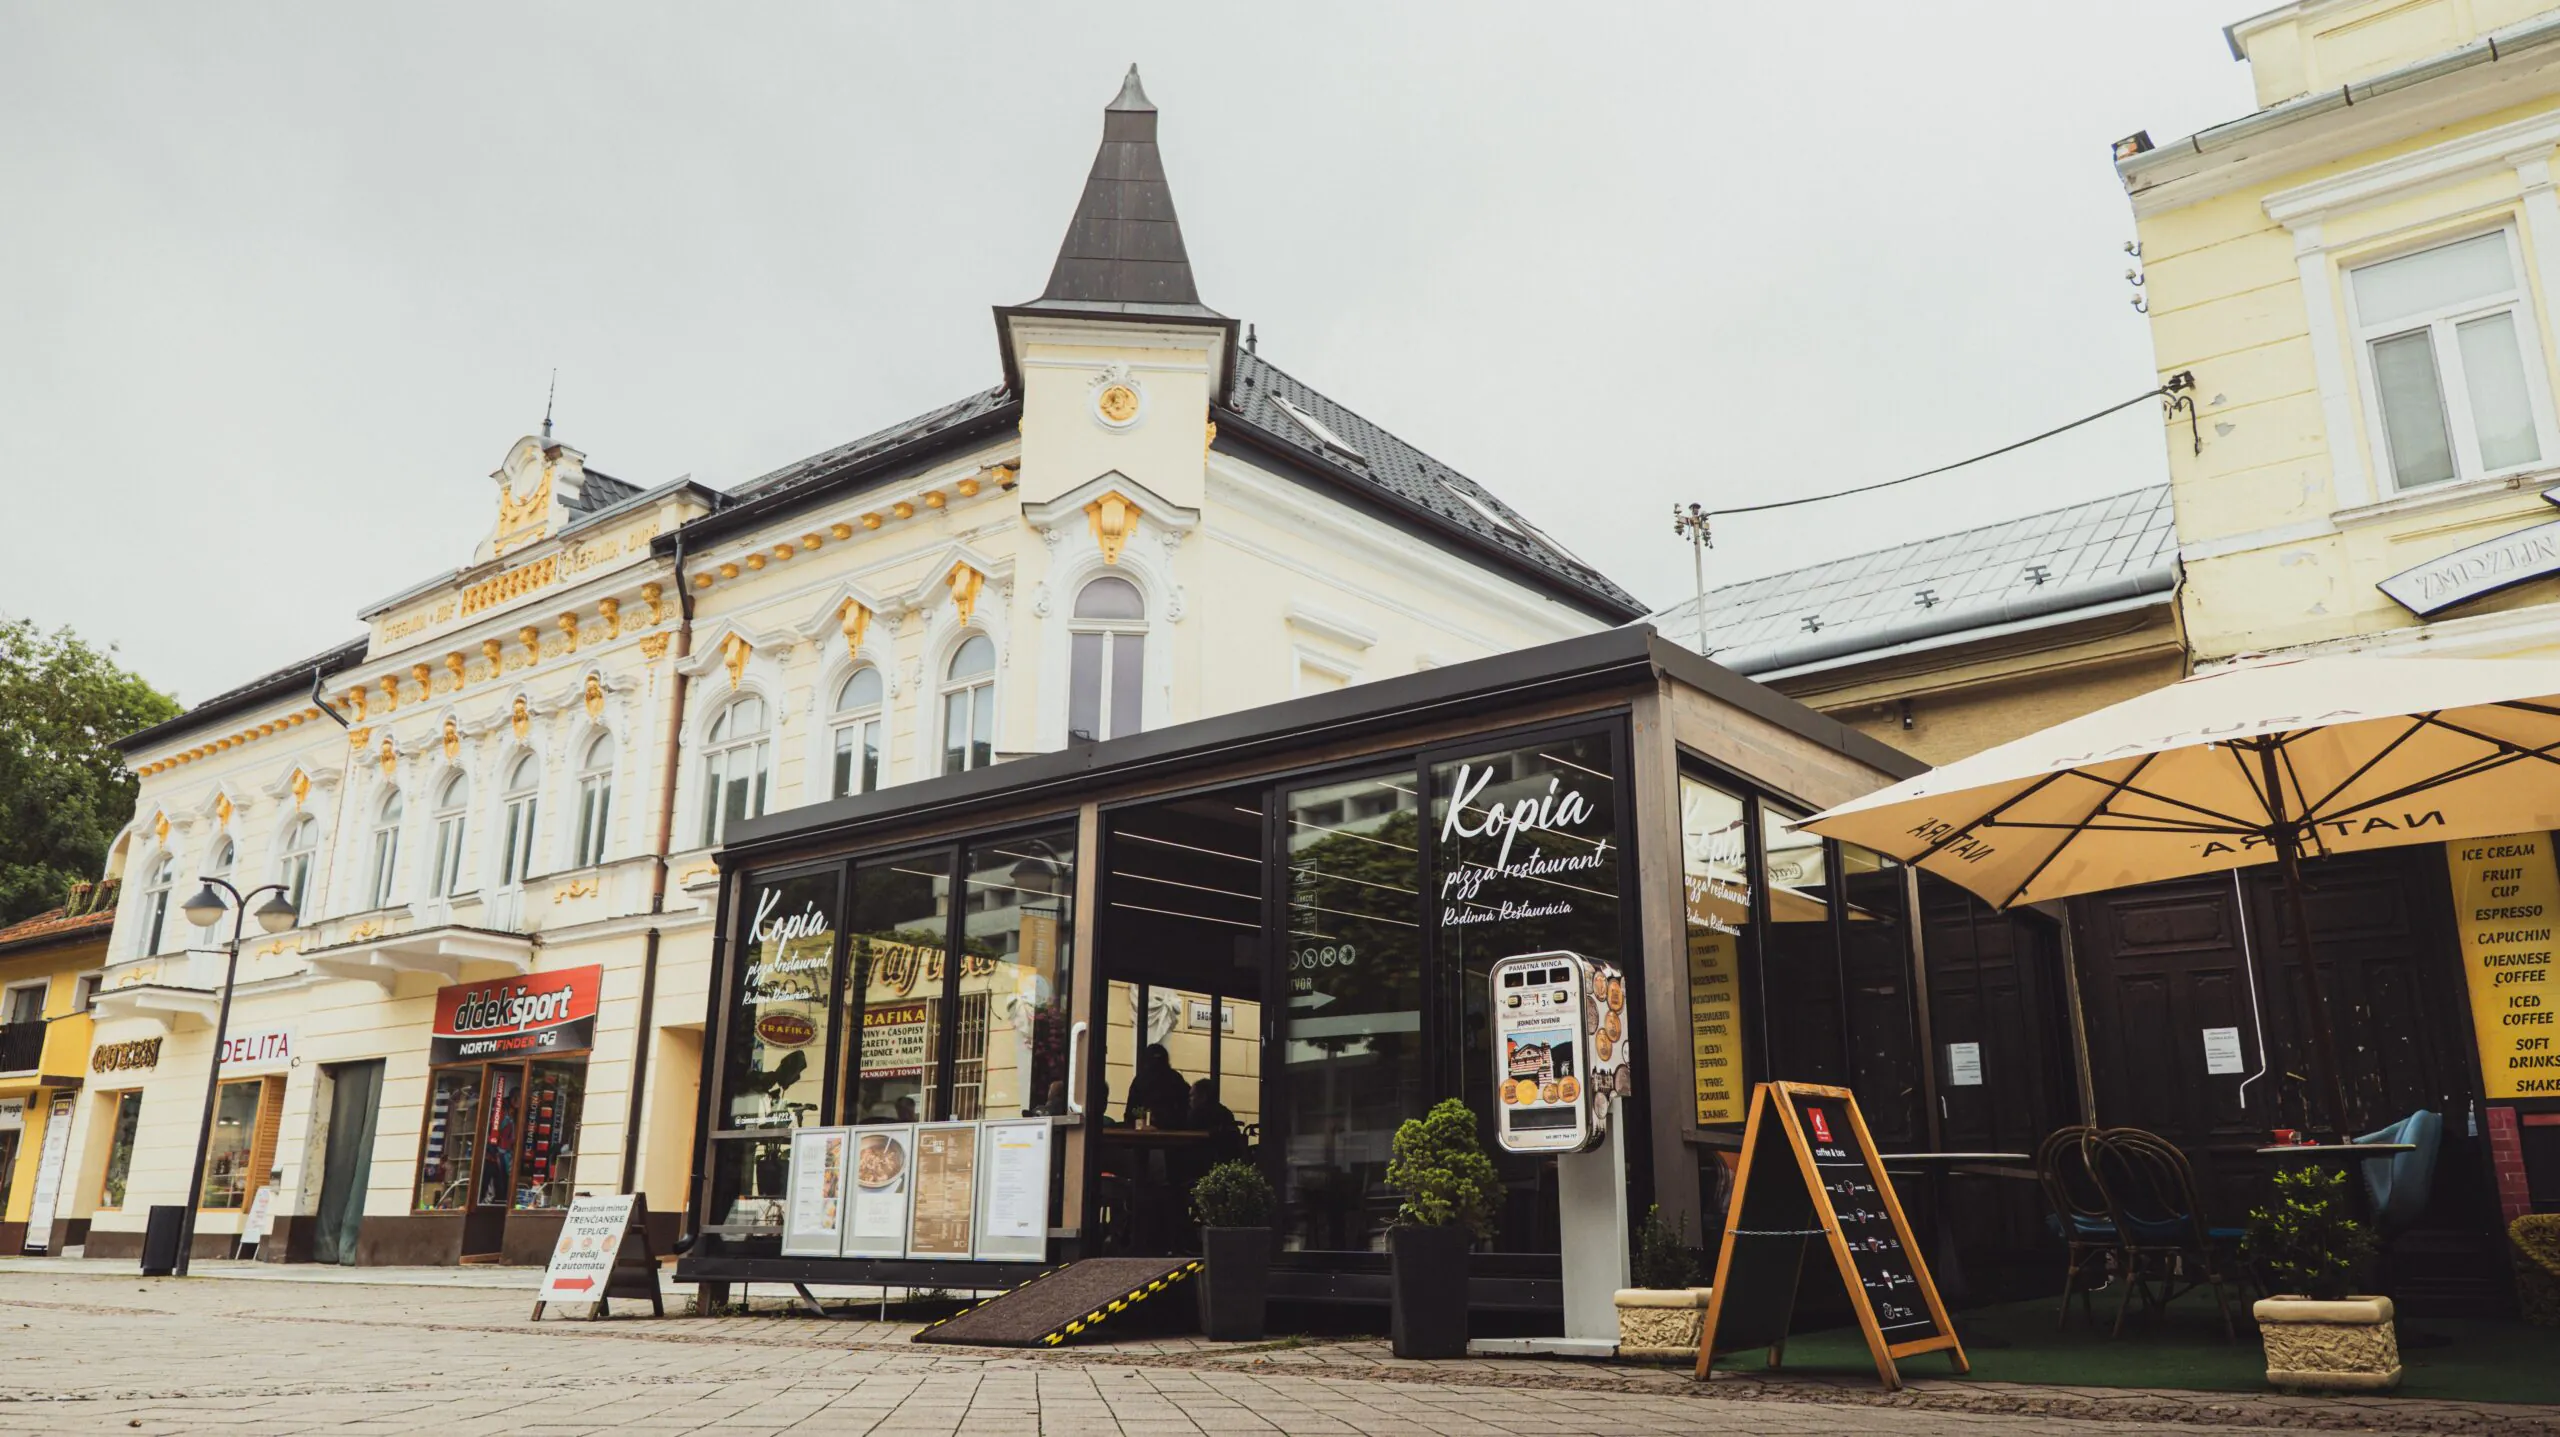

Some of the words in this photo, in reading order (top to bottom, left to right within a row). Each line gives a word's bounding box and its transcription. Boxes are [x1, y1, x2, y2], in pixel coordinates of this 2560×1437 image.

[2415, 535, 2557, 600] ZMRZLIN
[2050, 709, 2363, 767] NATURA
[1440, 763, 1595, 873] Kopia
[2462, 848, 2483, 861] ICE
[2487, 843, 2535, 859] CREAM
[1441, 864, 1499, 900] pizza
[1504, 838, 1607, 879] restaurant
[2482, 867, 2523, 882] FRUIT
[1710, 880, 1752, 907] restaurant
[2491, 885, 2520, 899] CUP
[1441, 902, 1496, 928] Rodinná
[2475, 904, 2543, 921] ESPRESSO
[747, 886, 829, 969] Kopia
[2477, 928, 2551, 945] CAPUCHIN
[743, 961, 776, 987] pizza
[777, 945, 833, 973] restaurant
[1541, 960, 1563, 968] MINCA
[2483, 951, 2552, 968] VIENNESE
[2495, 969, 2546, 984] COFFEE
[453, 983, 573, 1033] didekšport
[2509, 995, 2541, 1008] ICED
[863, 1008, 926, 1027] RAFIKA
[2502, 1011, 2554, 1026] COFFEE
[761, 1024, 812, 1036] TRAFIKA
[862, 1029, 881, 1039] VINY
[219, 1032, 289, 1064] DELITA
[459, 1035, 536, 1056] NORTHFINDER
[861, 1038, 889, 1050] GARETY
[902, 1045, 922, 1055] MAPY
[2515, 1037, 2550, 1051] SOFT
[2509, 1054, 2560, 1069] DRINKS
[1815, 1147, 1831, 1157] coffee
[569, 1215, 625, 1224] TRENČIANSKE
[577, 1227, 609, 1236] TEPLICE
[569, 1249, 600, 1261] predaj
[561, 1262, 606, 1270] automatu
